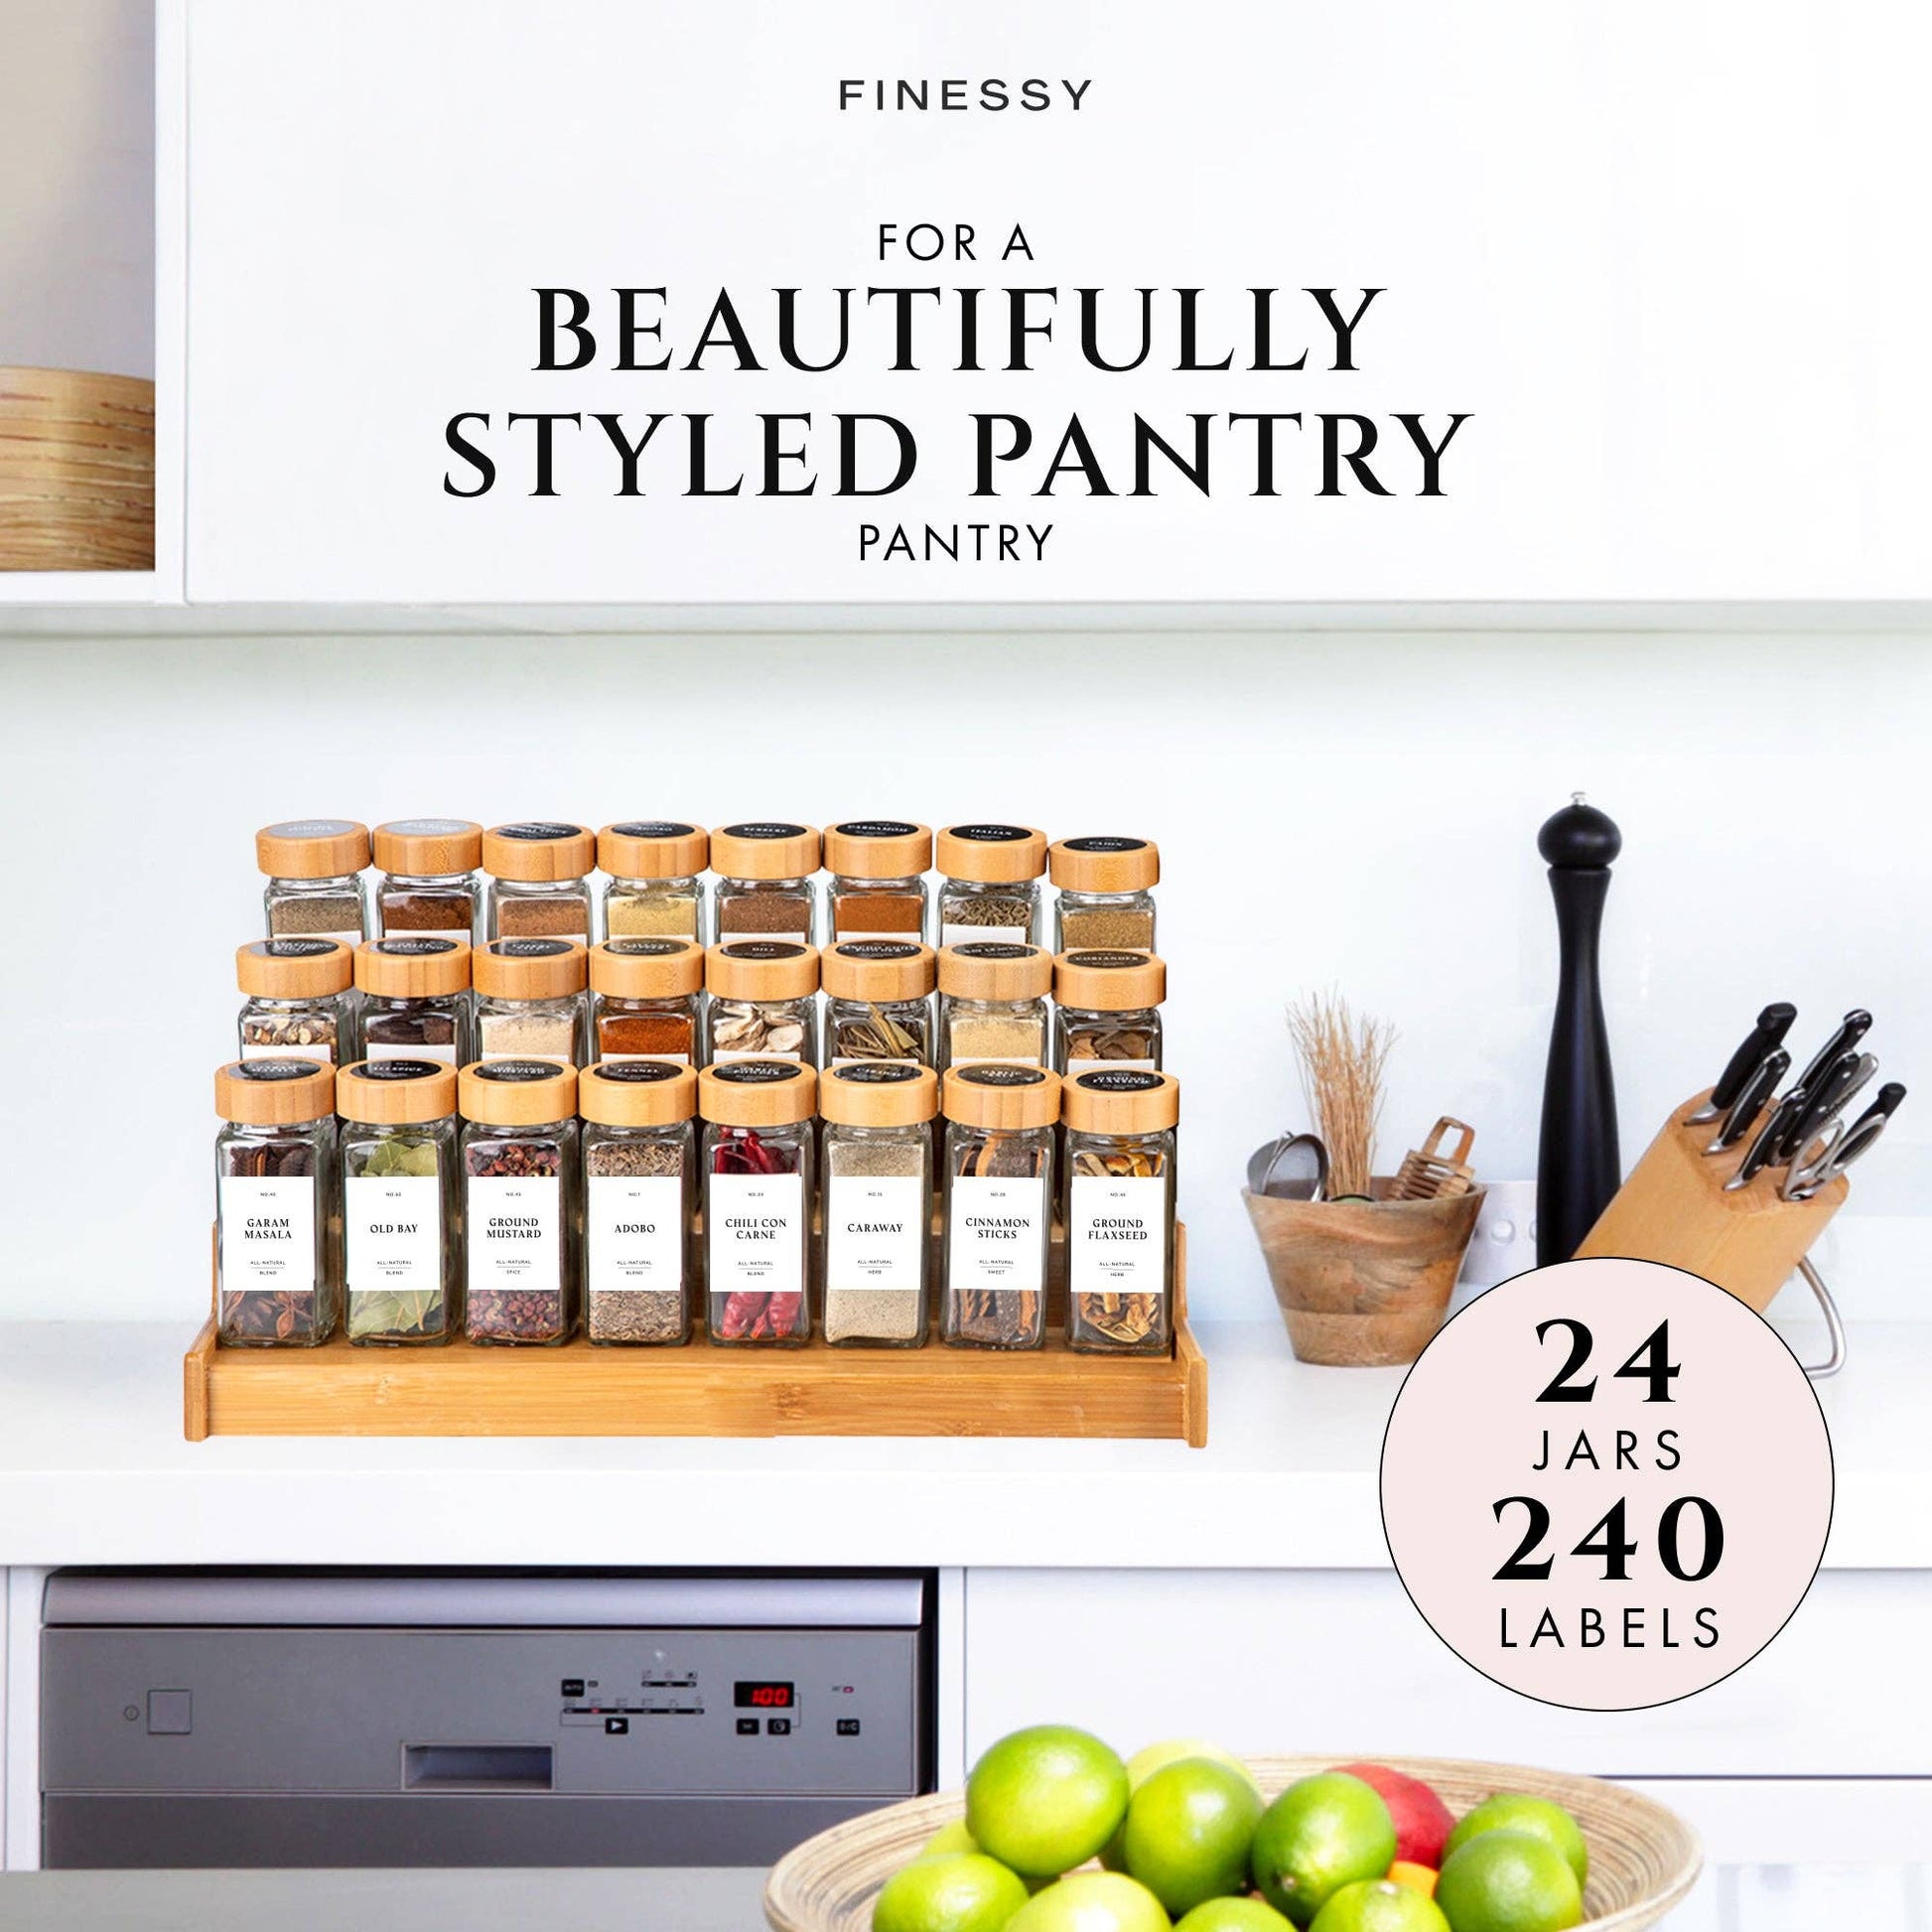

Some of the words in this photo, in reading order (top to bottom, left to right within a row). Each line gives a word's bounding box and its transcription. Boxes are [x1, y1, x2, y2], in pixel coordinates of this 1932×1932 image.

[246, 1218, 290, 1228] GARAM
[488, 1217, 539, 1227] GROUND
[725, 1218, 758, 1228] CHILI
[760, 1218, 787, 1228] CON
[847, 1222, 903, 1233] CARAWAY
[965, 1217, 1030, 1228] CINNAMON
[1092, 1218, 1144, 1229] GROUND
[369, 1223, 394, 1234] OLD
[396, 1223, 419, 1234] BAY
[486, 1229, 542, 1239] MUSTARD
[614, 1223, 656, 1234] ADOBO
[244, 1229, 292, 1240] MASALA
[736, 1229, 776, 1240] CARNE
[977, 1229, 1018, 1240] STICKS
[1088, 1230, 1148, 1241] FLAXSEED
